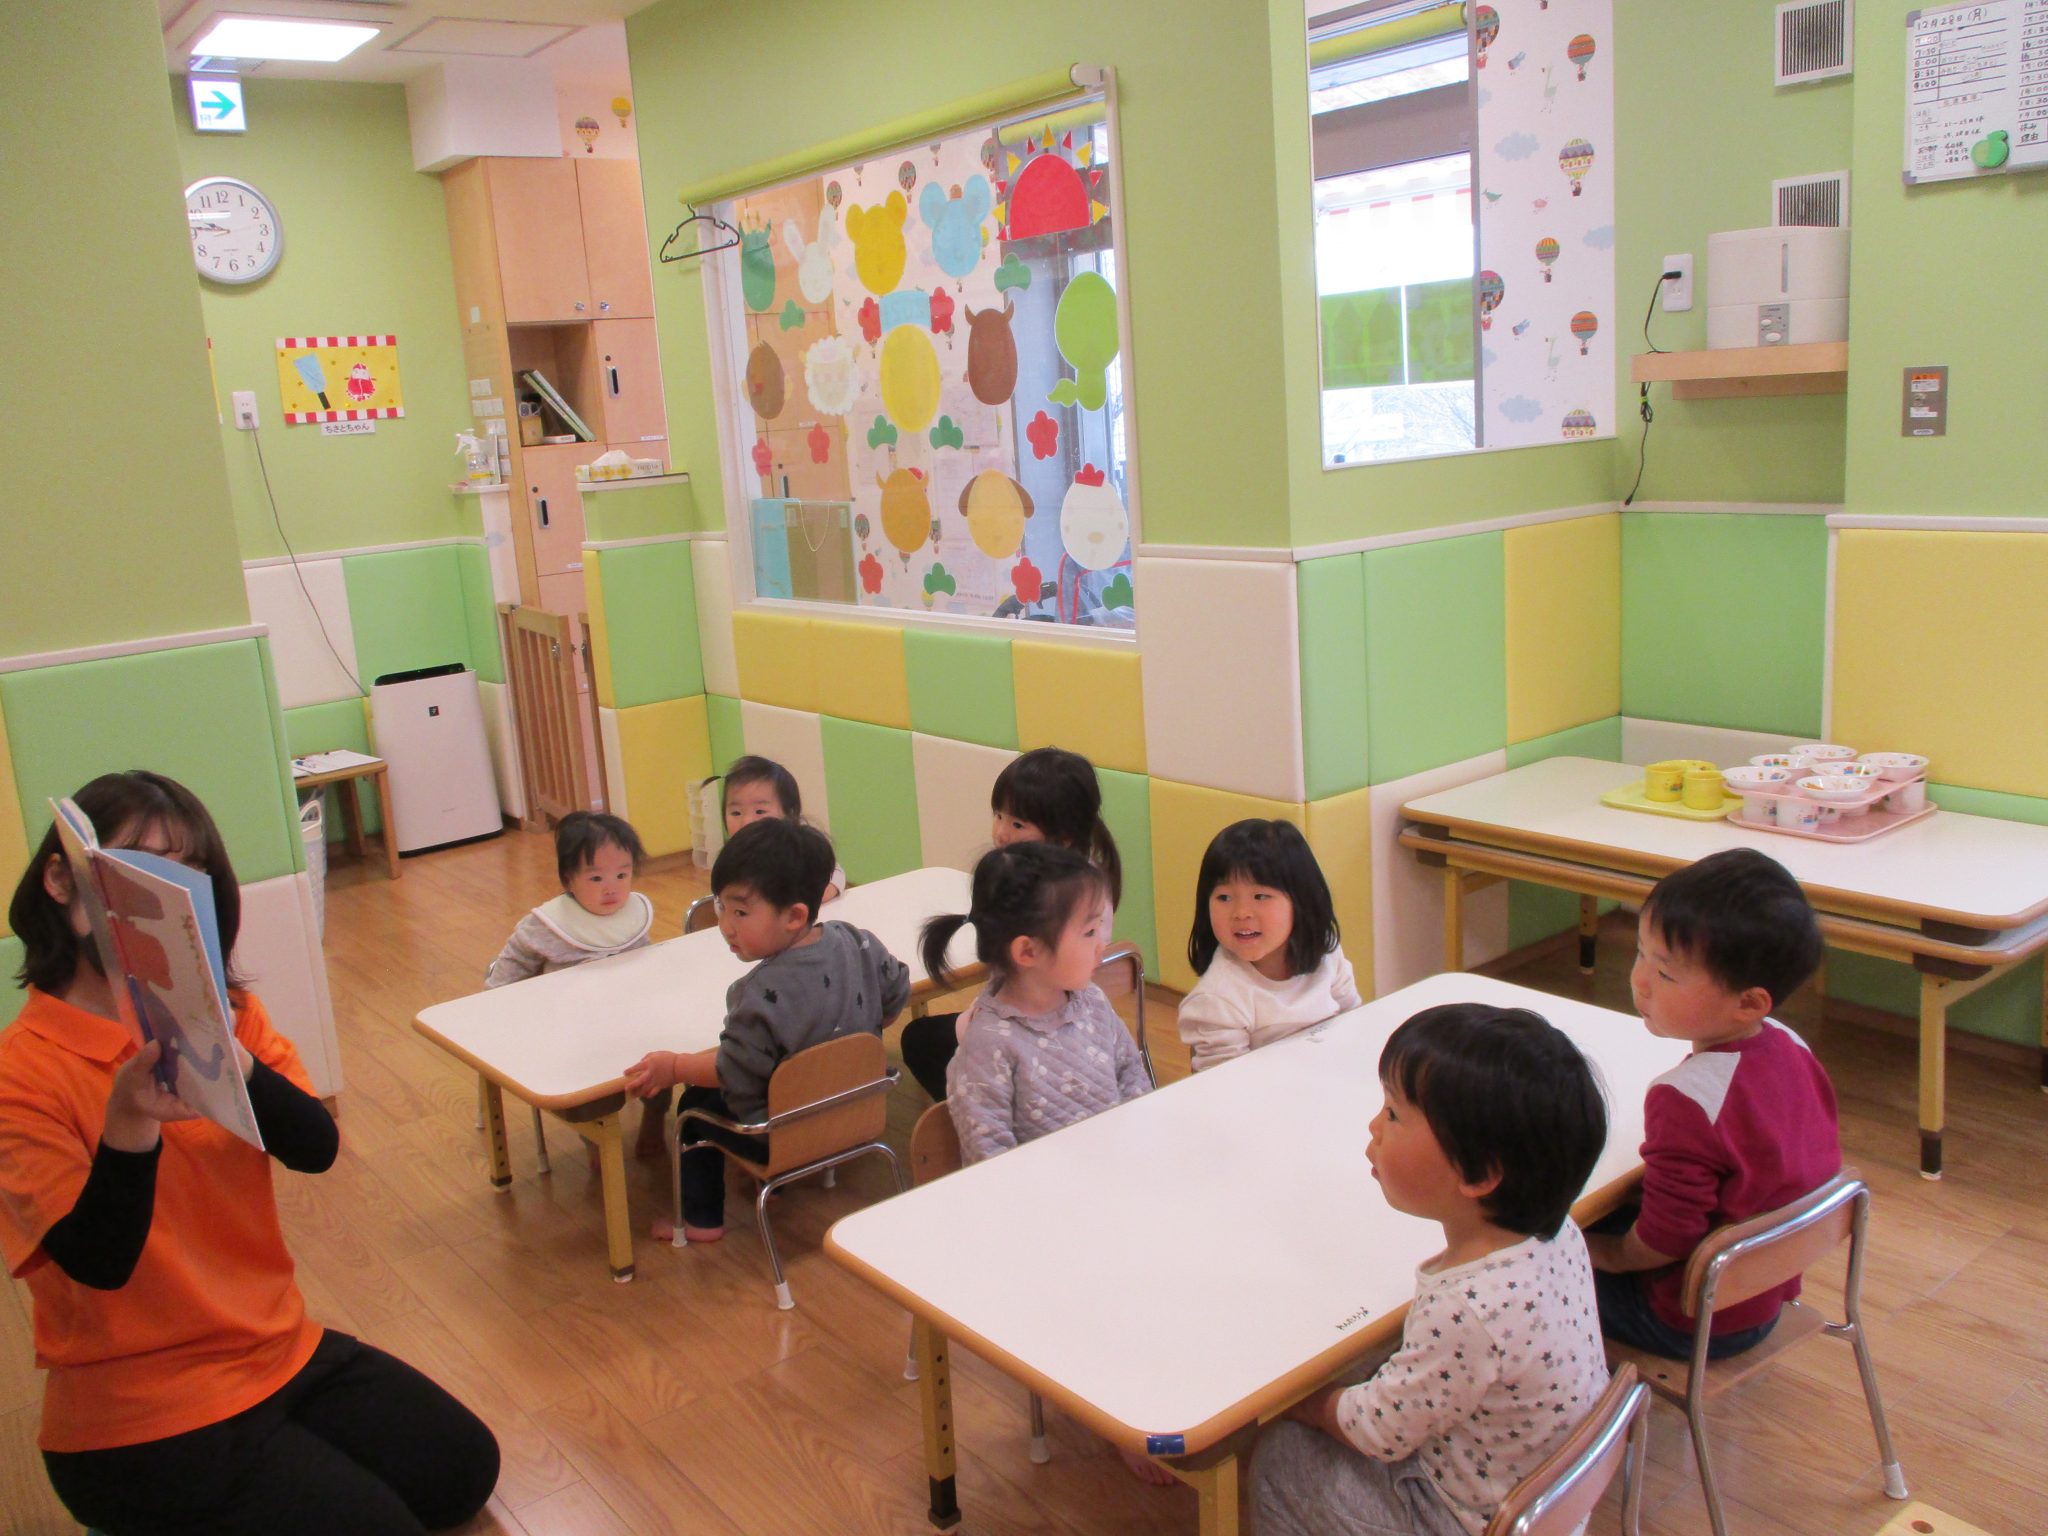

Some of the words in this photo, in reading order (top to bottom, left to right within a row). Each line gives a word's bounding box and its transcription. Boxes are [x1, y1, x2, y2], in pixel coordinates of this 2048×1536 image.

[200, 195, 212, 208] 11
[216, 191, 229, 204] 12
[239, 194, 244, 207] 1
[251, 206, 260, 219] 2
[259, 224, 269, 236] 3
[197, 244, 208, 257] 8
[257, 241, 264, 253] 4
[212, 256, 221, 269] 7
[229, 259, 239, 272] 6
[247, 255, 255, 267] 5
